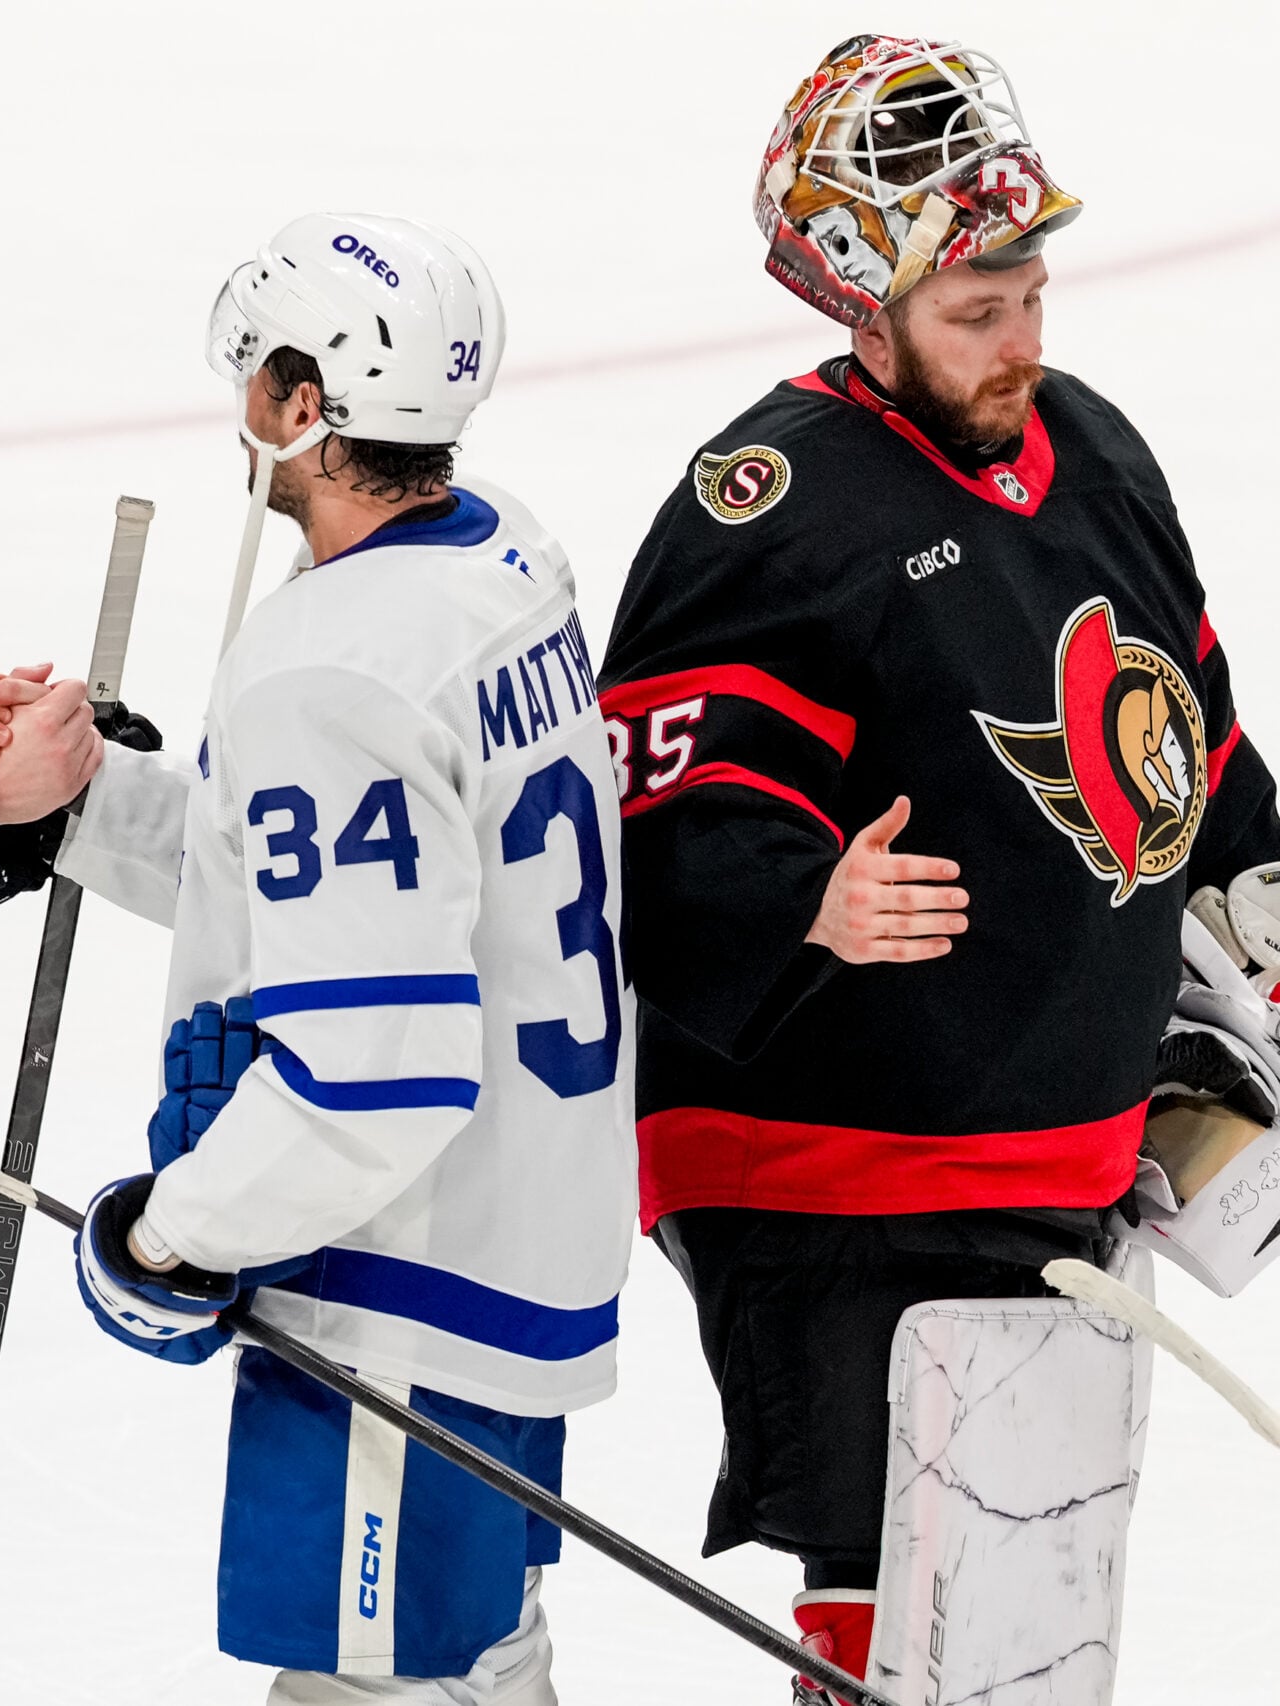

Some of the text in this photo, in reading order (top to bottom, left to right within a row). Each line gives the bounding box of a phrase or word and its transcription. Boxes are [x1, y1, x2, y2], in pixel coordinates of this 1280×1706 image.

[331, 234, 400, 288] OREO
[446, 340, 481, 382] 34
[723, 461, 771, 507] S
[906, 545, 946, 580] CIBC
[477, 607, 597, 763] MATTH
[246, 777, 420, 902] 34
[500, 754, 632, 1099] 3
[359, 1511, 383, 1621] CCM
